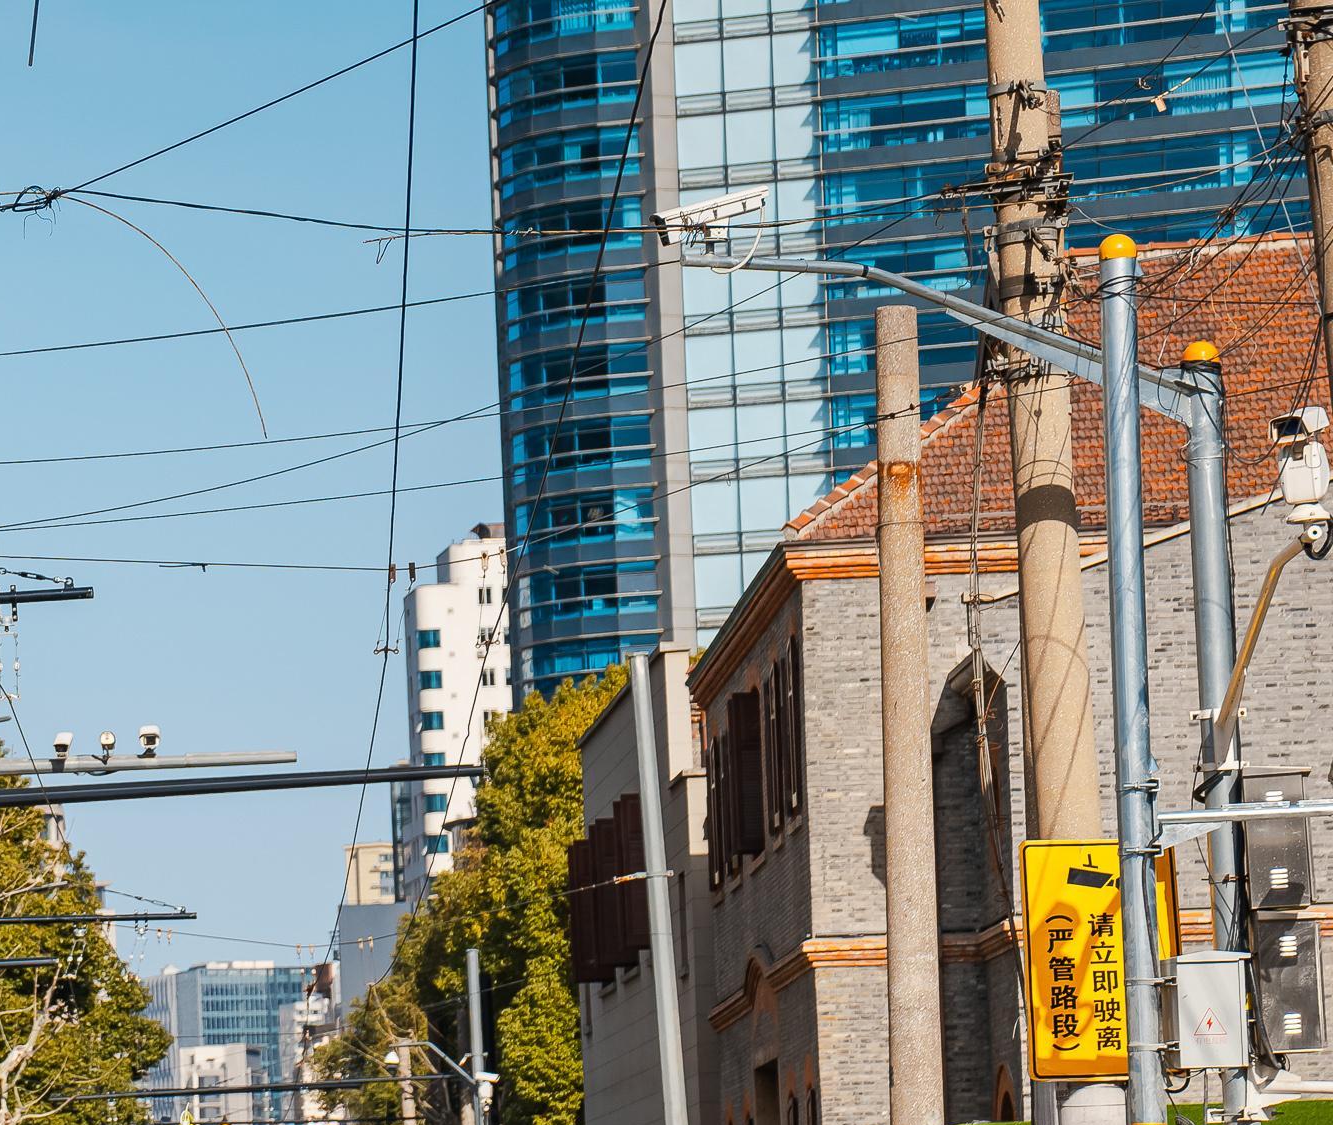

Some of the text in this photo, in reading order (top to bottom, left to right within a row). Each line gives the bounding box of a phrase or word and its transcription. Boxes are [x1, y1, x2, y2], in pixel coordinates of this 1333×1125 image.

[1088, 912, 1122, 1051] 请立即驶离
